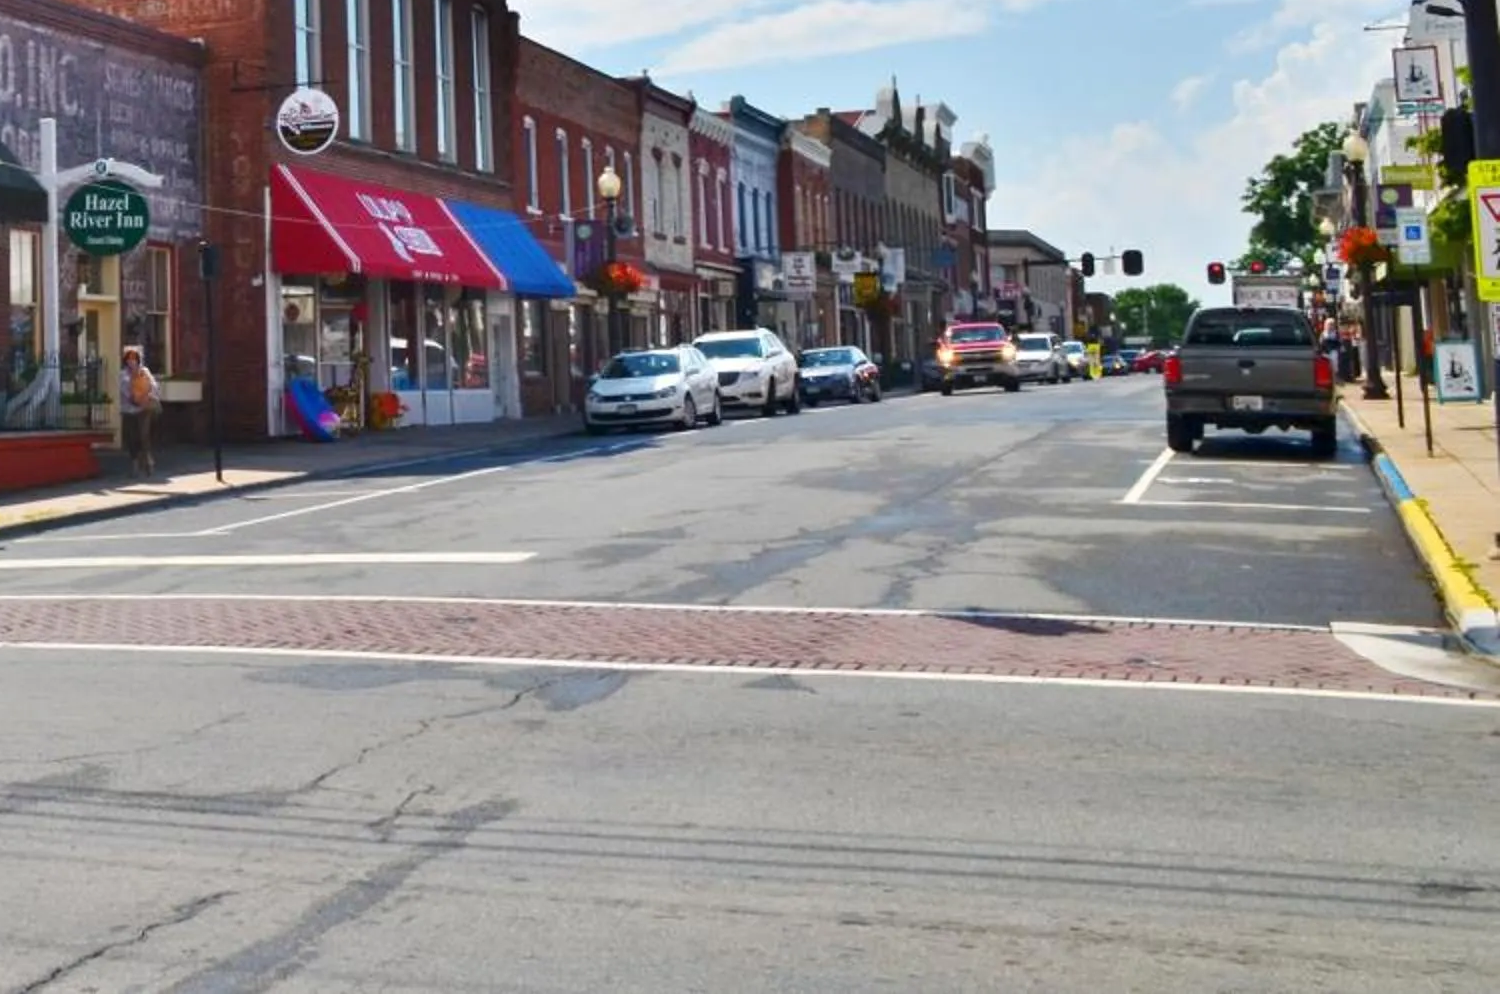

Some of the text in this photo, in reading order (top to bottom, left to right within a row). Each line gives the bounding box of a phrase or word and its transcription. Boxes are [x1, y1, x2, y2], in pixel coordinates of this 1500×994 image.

[85, 193, 130, 211] Hazel
[70, 211, 144, 229] River Inn
